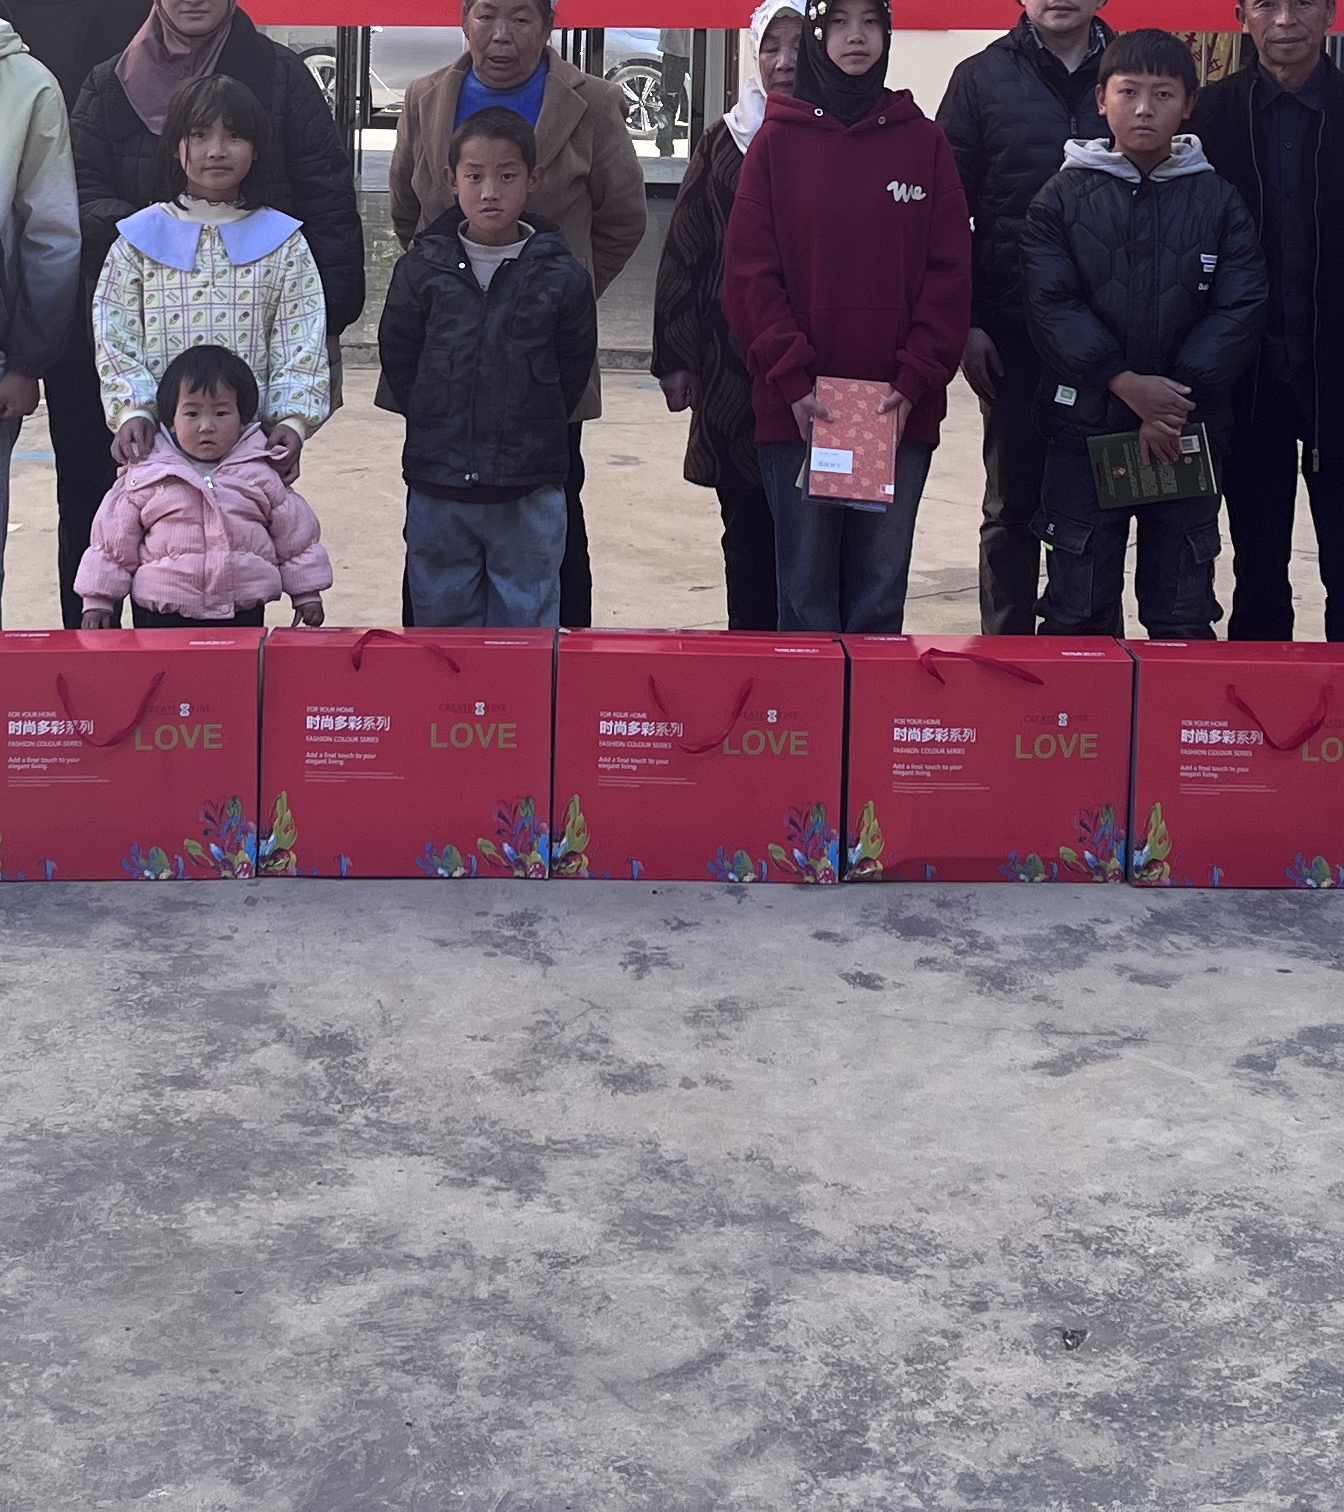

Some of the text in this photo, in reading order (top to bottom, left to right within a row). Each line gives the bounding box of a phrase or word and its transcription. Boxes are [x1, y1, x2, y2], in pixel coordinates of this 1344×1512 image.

[306, 715, 390, 731] 时尚多彩系列
[599, 720, 684, 737] 时尚多彩系列
[135, 724, 222, 750] LOVE
[430, 722, 517, 748] LOVE
[722, 730, 808, 755] LOVE
[894, 727, 976, 742] 时尚多彩系列
[1181, 729, 1263, 745] 时尚多彩系列
[1016, 734, 1098, 758] LOVE
